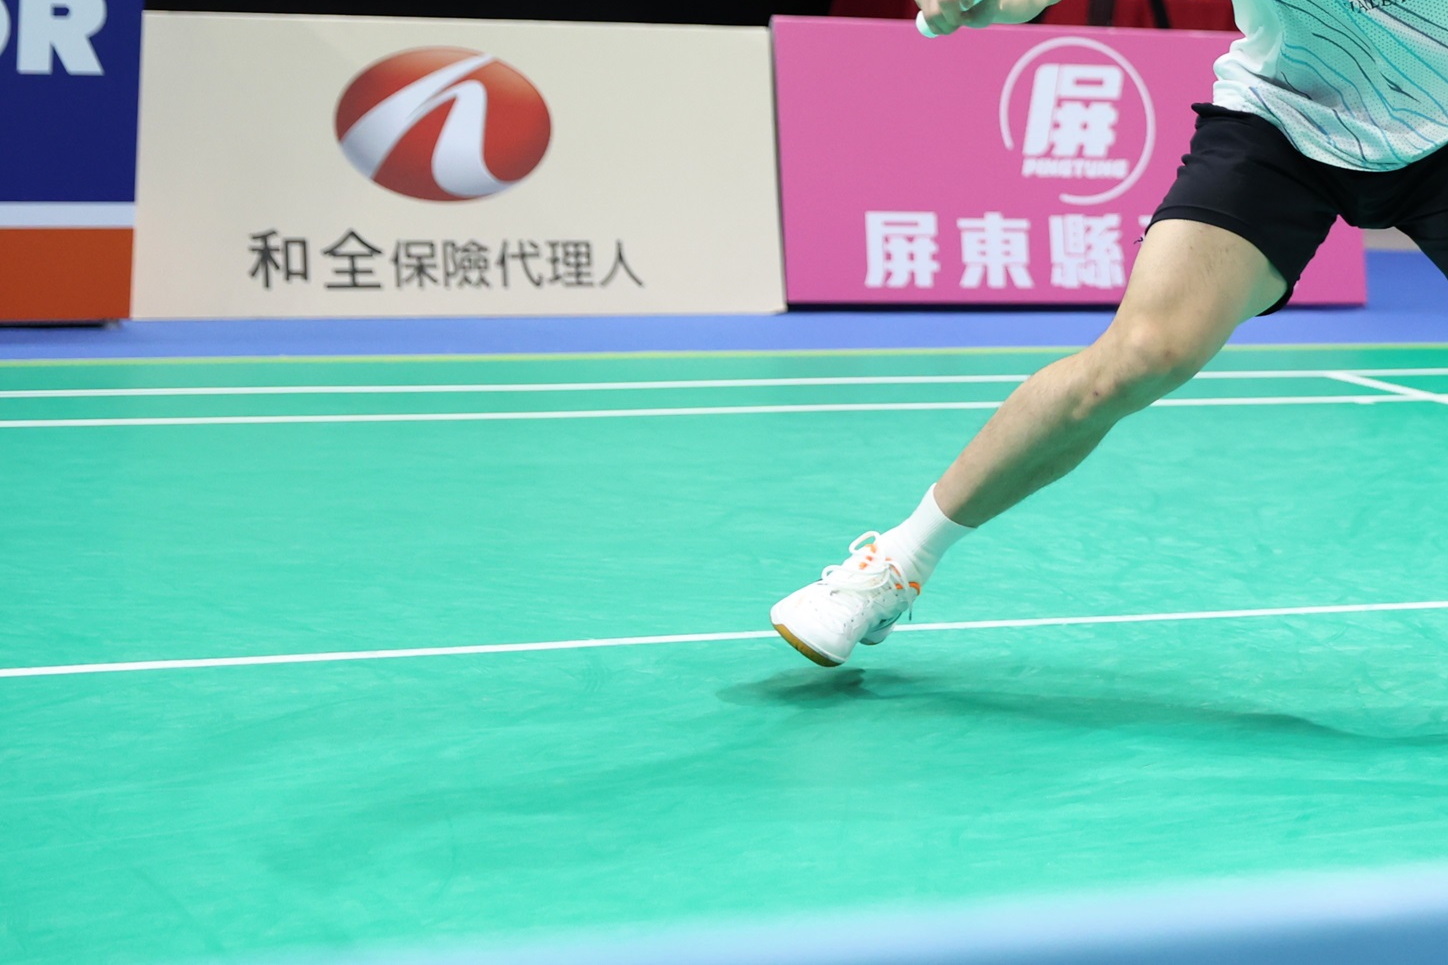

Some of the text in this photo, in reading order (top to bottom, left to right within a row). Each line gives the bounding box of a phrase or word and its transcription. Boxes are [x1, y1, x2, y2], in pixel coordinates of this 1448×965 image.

[1022, 62, 1124, 156] 屏
[249, 228, 645, 293] 和全保險代理人
[865, 211, 1152, 289] 屏東縣
